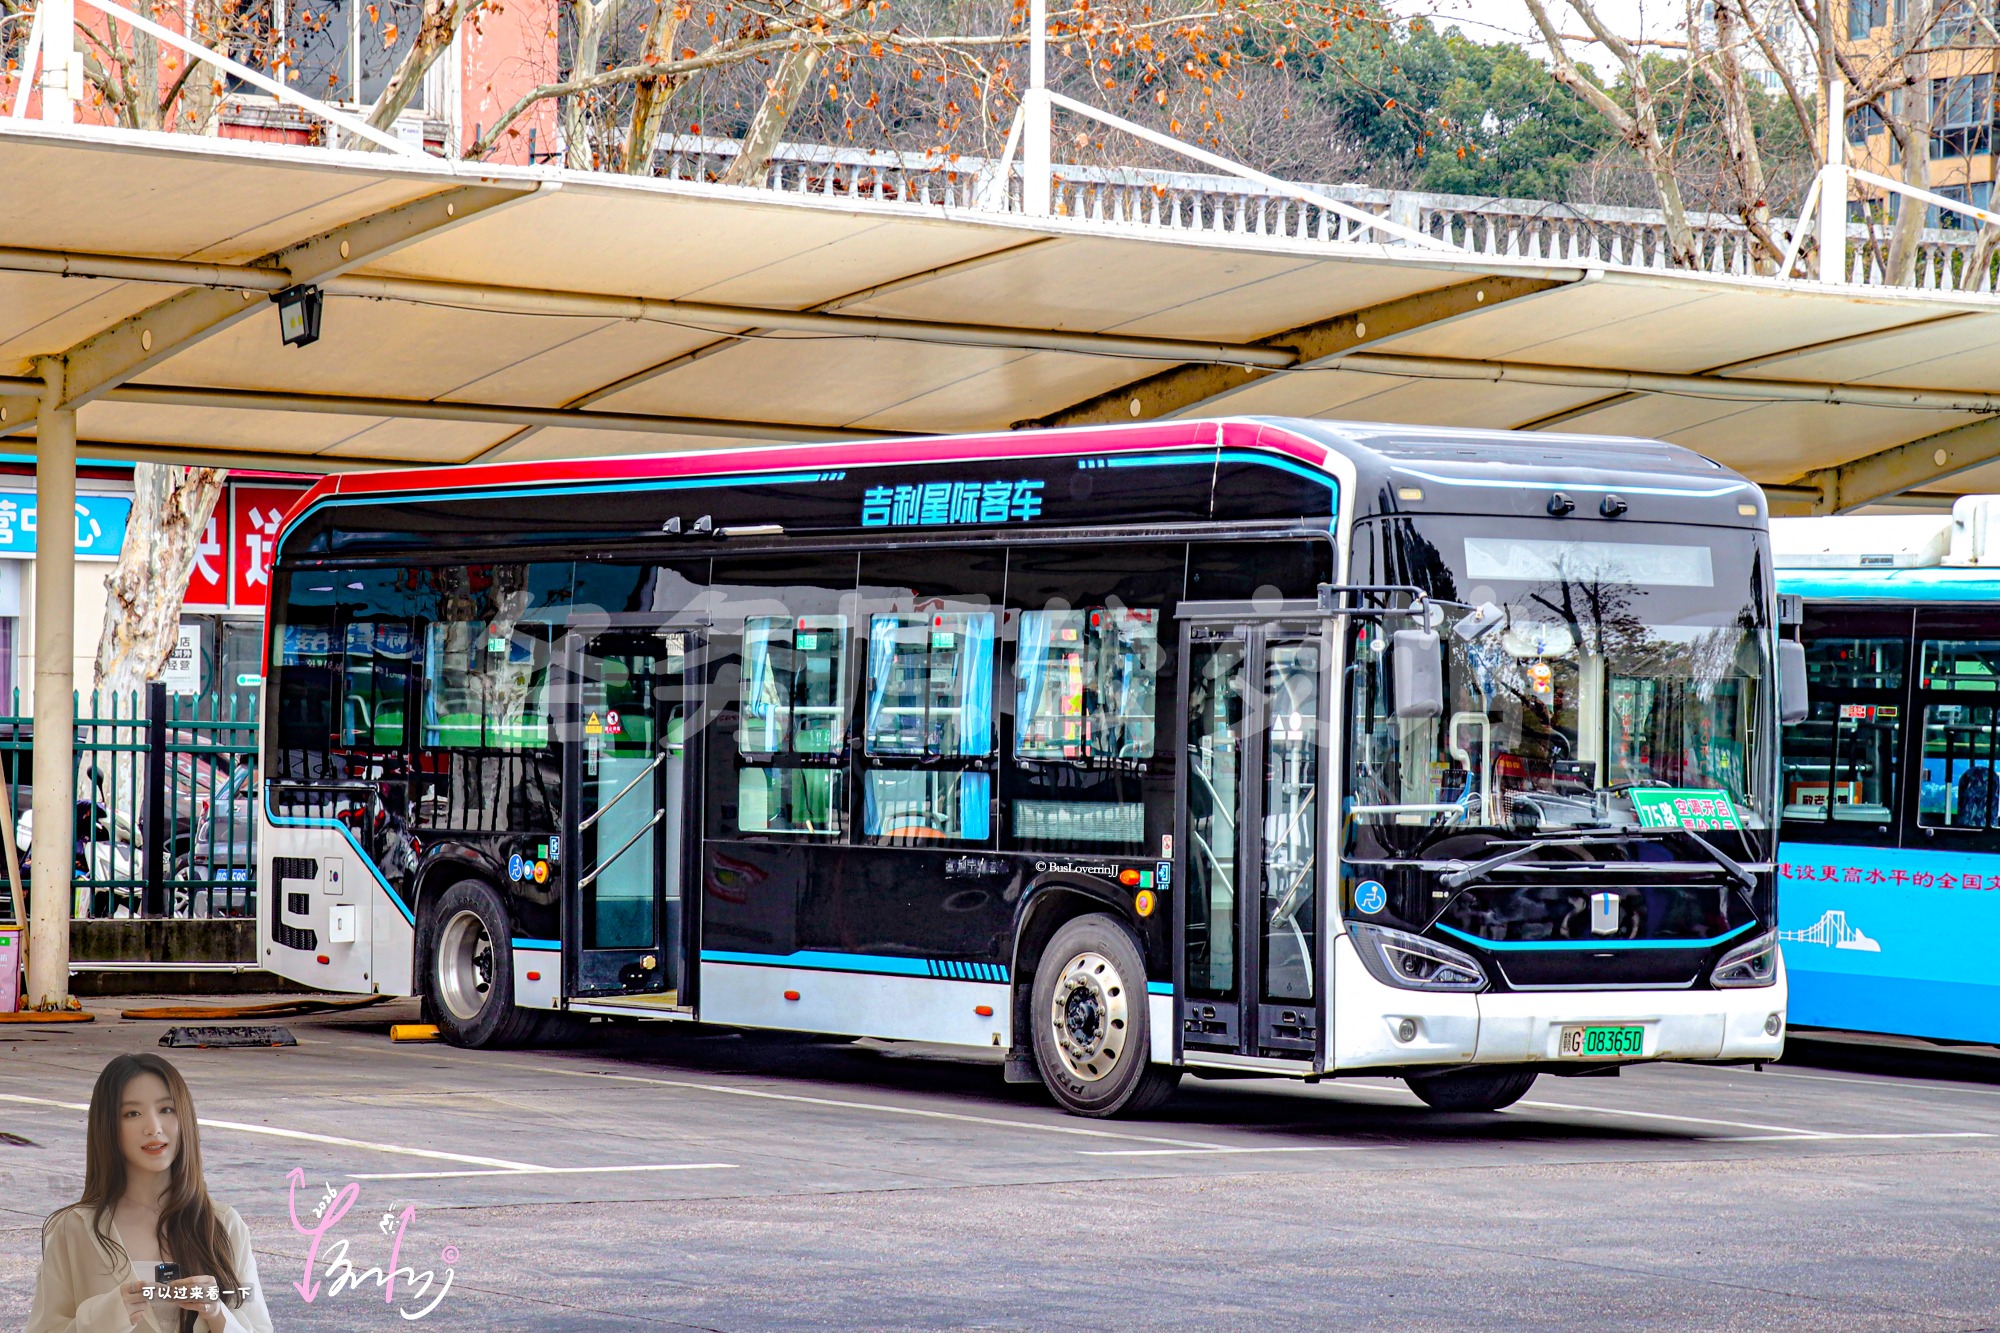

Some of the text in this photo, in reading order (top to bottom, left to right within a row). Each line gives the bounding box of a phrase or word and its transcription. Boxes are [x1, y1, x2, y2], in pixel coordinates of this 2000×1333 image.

[862, 480, 1045, 527] 吉利星际客车
[1674, 798, 1731, 818] 空调开启
